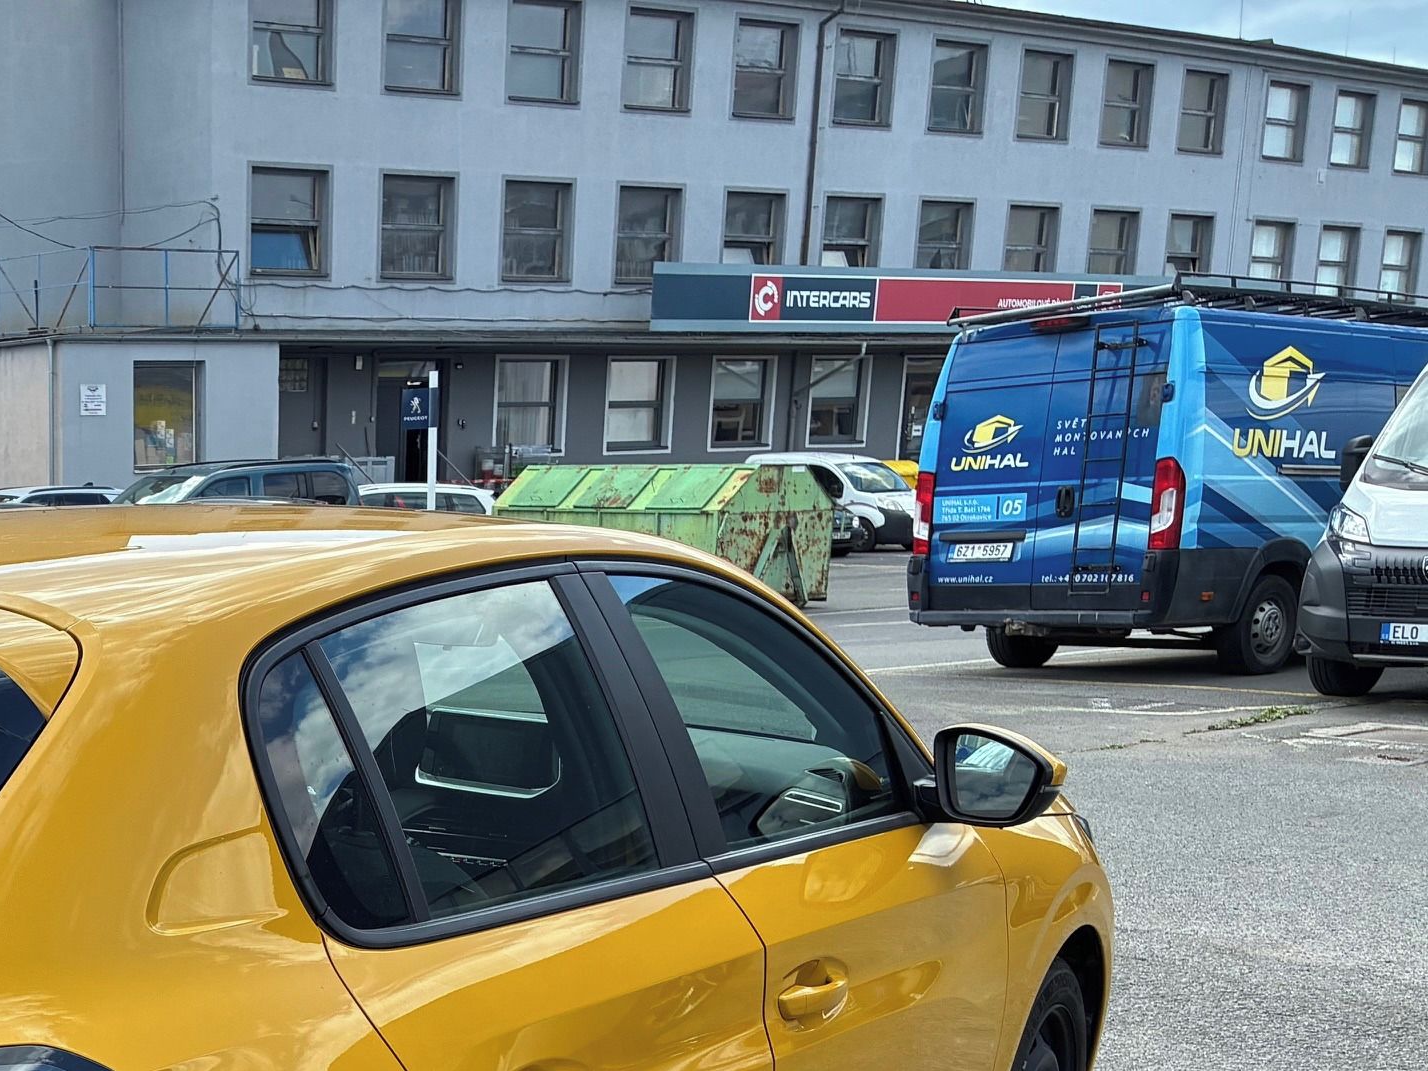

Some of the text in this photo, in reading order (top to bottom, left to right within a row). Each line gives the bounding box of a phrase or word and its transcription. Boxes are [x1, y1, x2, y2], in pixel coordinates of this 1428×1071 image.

[785, 290, 871, 309] INTERCARS
[1054, 428, 1150, 443] MONOVANCH
[1232, 428, 1336, 459] UNIHAL
[1053, 446, 1077, 457] HAL
[950, 453, 1029, 472] UNIHAL
[1002, 499, 1023, 516] 05
[956, 544, 1008, 558] 6Z1 5957
[937, 574, 994, 583] www.unihal.cz
